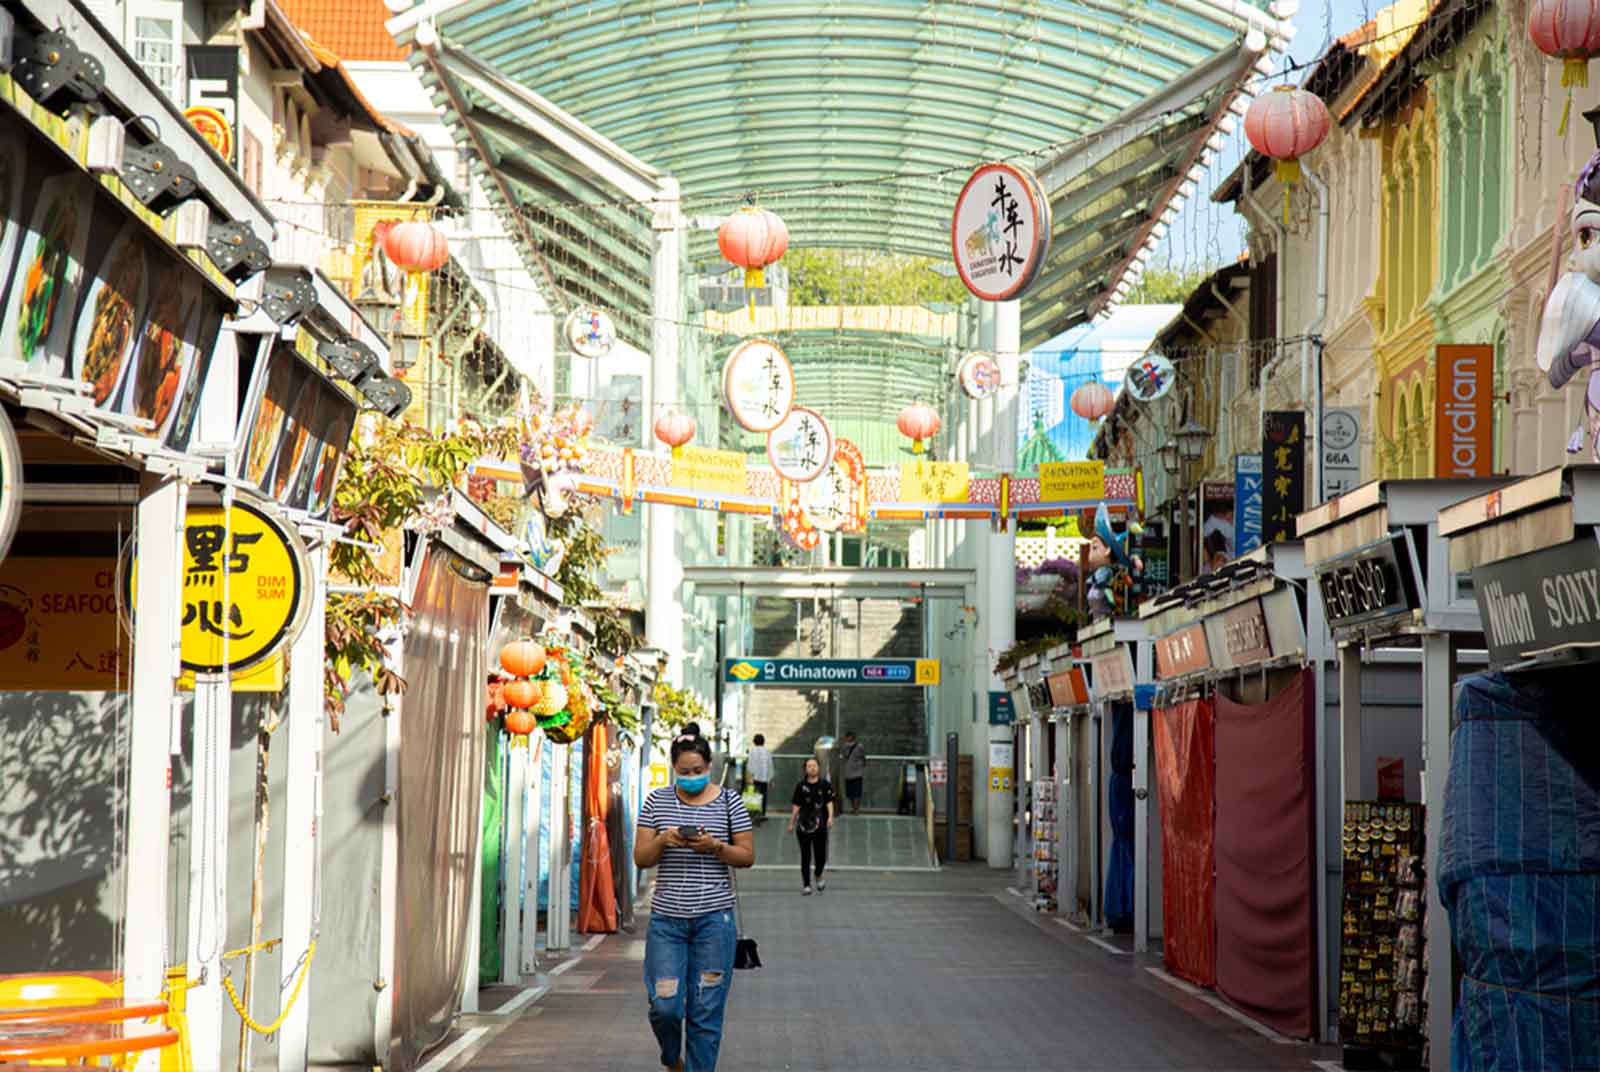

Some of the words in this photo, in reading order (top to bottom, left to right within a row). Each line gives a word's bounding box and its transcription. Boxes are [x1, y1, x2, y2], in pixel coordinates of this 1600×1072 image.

[1445, 358, 1476, 477] uardian
[257, 576, 286, 587] DIM
[257, 588, 286, 600] SUM
[40, 594, 118, 613] SEAFOO
[1484, 580, 1536, 647] Nikon
[1542, 568, 1600, 628] SONY
[780, 662, 857, 679] Chinatown
